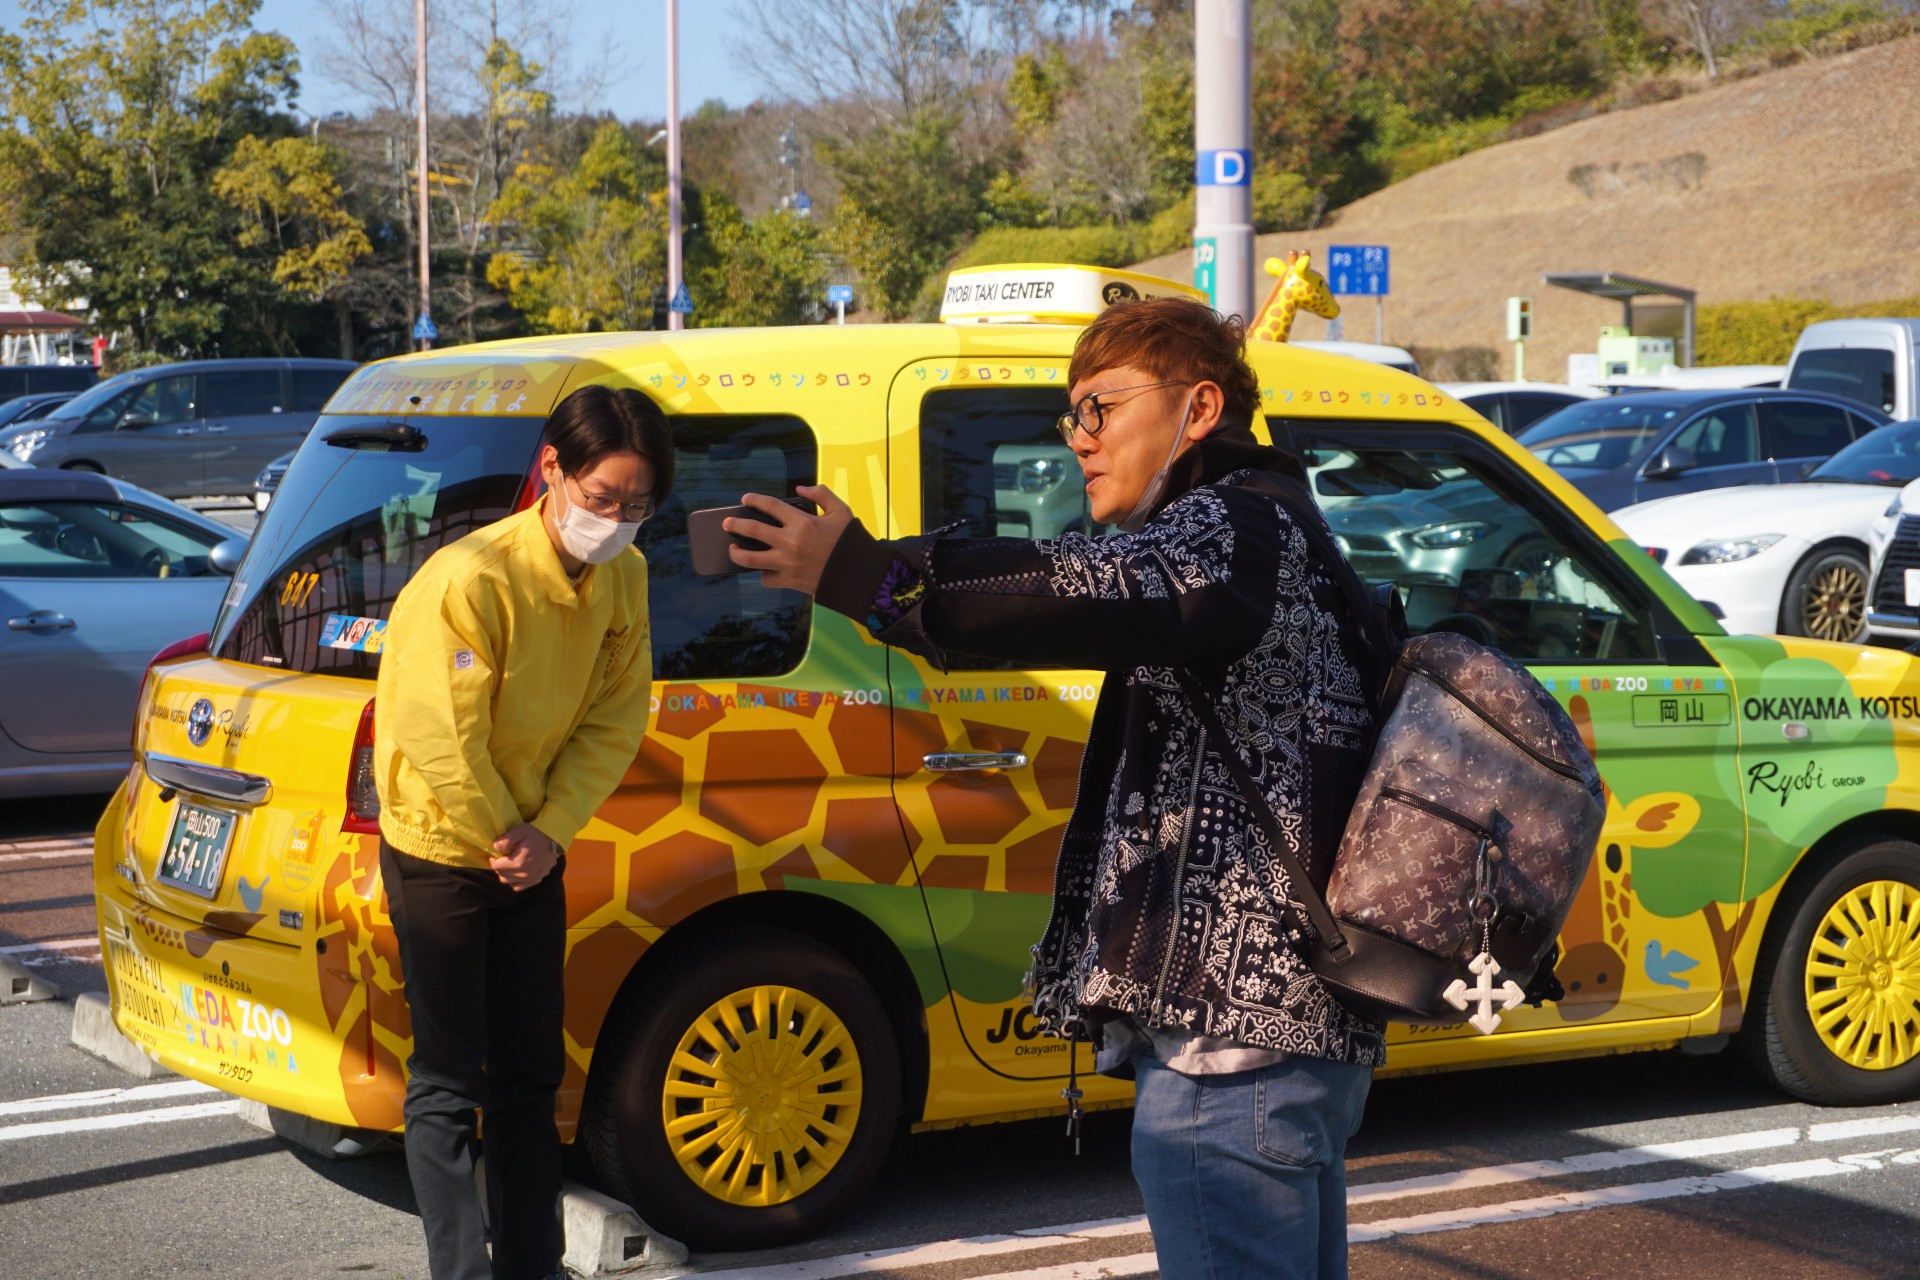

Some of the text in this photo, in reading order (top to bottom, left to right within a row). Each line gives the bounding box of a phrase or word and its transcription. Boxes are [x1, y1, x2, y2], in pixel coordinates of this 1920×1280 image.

[1215, 151, 1245, 184] D
[1333, 252, 1352, 266] P3
[1364, 247, 1384, 261] P2
[946, 282, 1055, 303] RYOBI TAXI CENTER
[649, 373, 871, 388] サンタロウ サンタロウ
[914, 367, 1012, 381] サンタロウ
[1263, 388, 1443, 406] サンタロウ サンタロウ
[281, 571, 320, 609] 647
[993, 686, 1049, 702] IKEDA
[1058, 685, 1096, 701] ZOO
[1615, 676, 1648, 692] ZOO
[667, 691, 766, 712] OKAYAMA
[778, 690, 838, 707] IKEDA
[843, 689, 882, 706] ZOO
[1660, 698, 1704, 723] 岡山
[1744, 697, 1853, 721] OKAYAMA
[216, 709, 252, 749] Ryobi
[1748, 760, 1866, 808] Ryobi GROUP
[291, 839, 306, 851] ZOO
[173, 837, 222, 889] 54-18
[179, 981, 292, 1046] IKEDA ZOO
[186, 1023, 299, 1075] OKAYAMA
[1015, 1043, 1067, 1056] Okayama
[219, 1061, 253, 1083] サンタロウ
